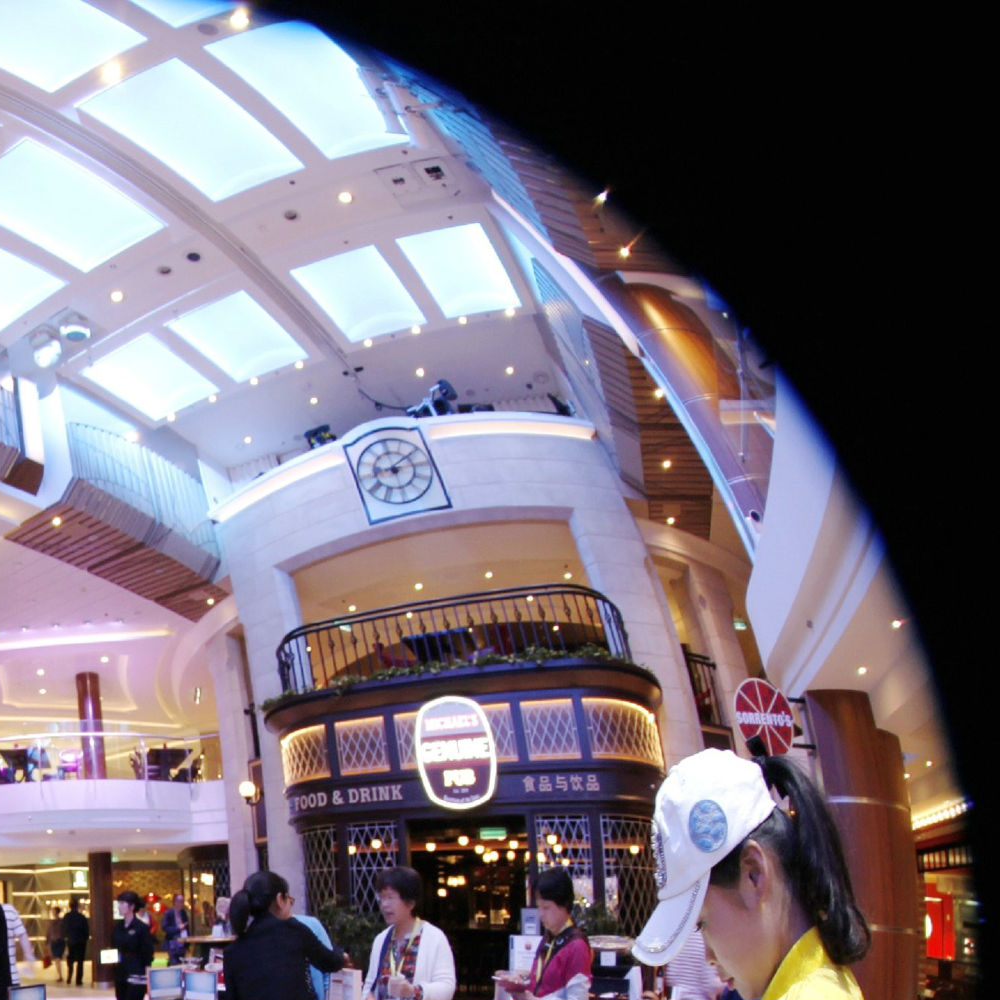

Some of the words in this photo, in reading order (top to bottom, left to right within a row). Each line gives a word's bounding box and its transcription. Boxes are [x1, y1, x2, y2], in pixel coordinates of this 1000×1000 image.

[736, 711, 792, 727] SORRENTO'S
[421, 737, 490, 763] GENUINE
[443, 768, 476, 787] PUB
[522, 774, 601, 793] 食品与饮品
[294, 792, 327, 811] FOOD
[332, 790, 345, 805] &
[348, 785, 403, 803] DRINK
